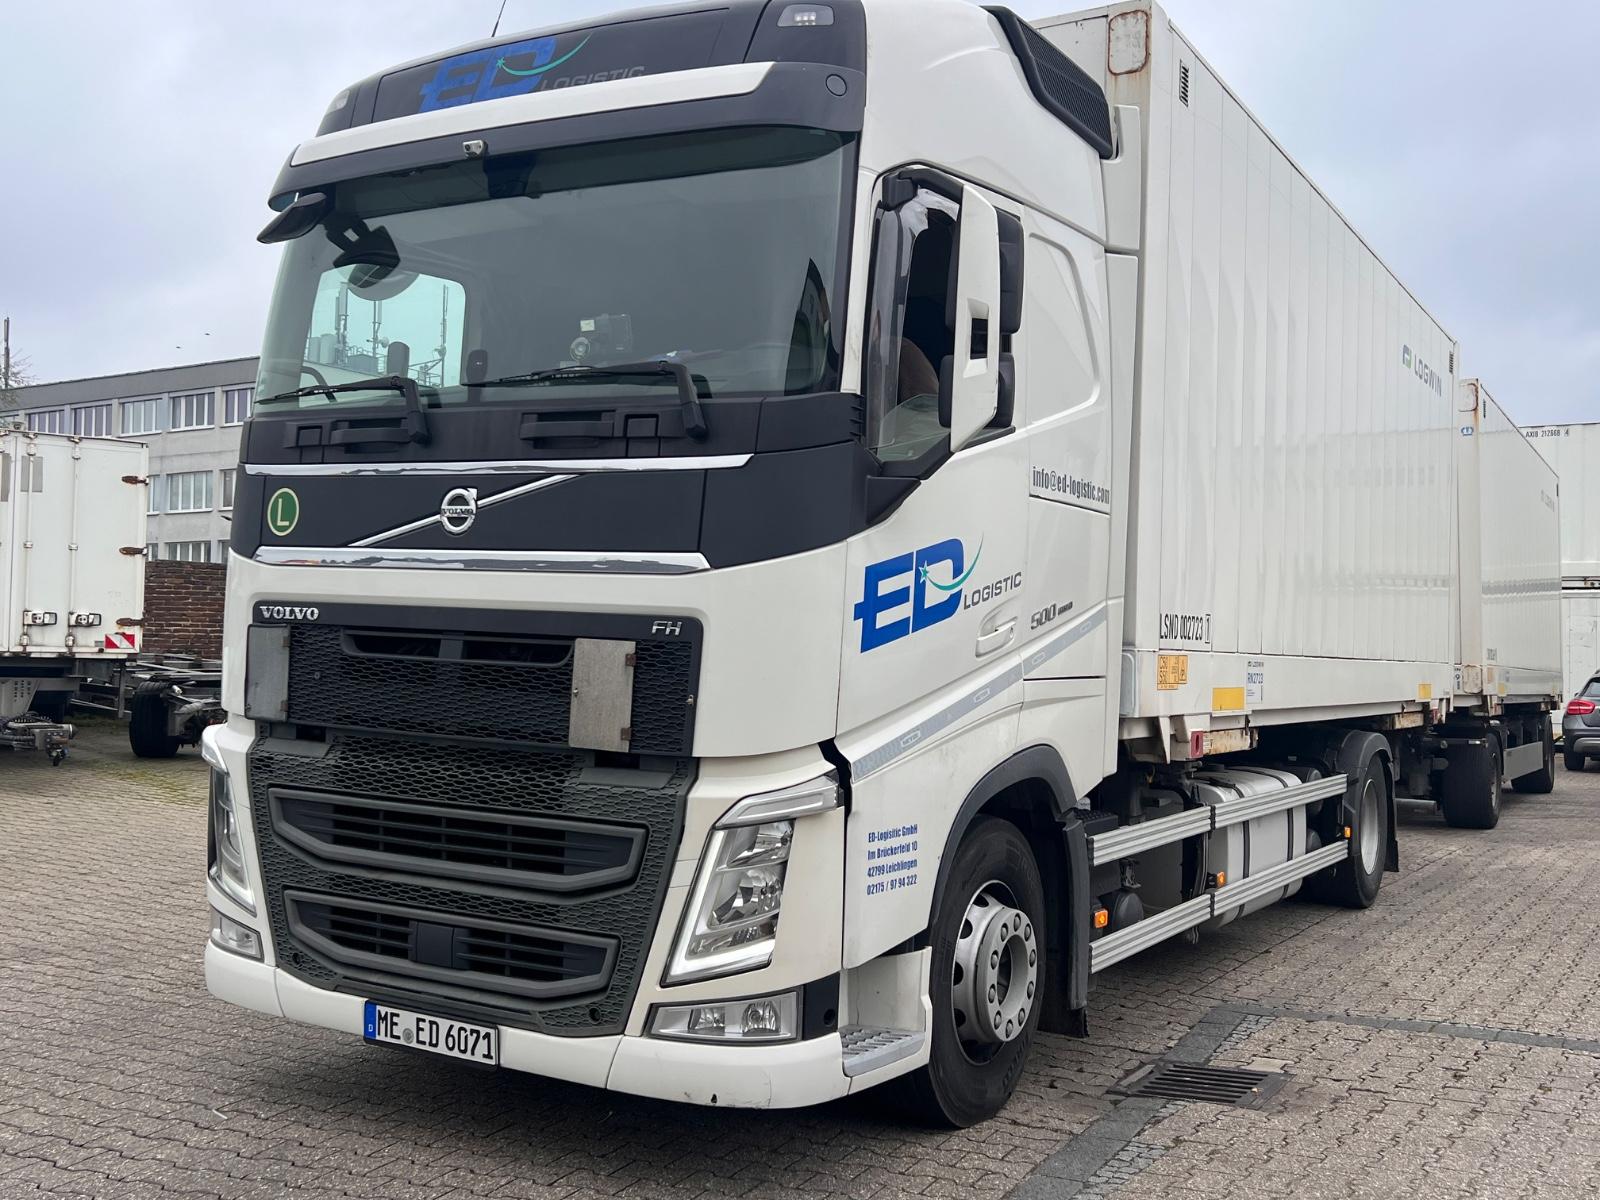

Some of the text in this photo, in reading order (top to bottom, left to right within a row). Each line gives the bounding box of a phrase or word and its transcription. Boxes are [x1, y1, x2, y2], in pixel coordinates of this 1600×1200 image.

[1415, 354, 1442, 397] LOGWIN
[1033, 466, 1110, 504] info@ed-logistic.com
[277, 499, 290, 526] L
[441, 508, 475, 516] VOLVO
[854, 538, 964, 654] ED
[963, 571, 1022, 610] LOGISTIC
[260, 606, 319, 620] VOLVO
[1031, 603, 1056, 630] 500
[652, 620, 682, 635] FH
[1160, 613, 1178, 640] LSND
[1180, 614, 1203, 641] 002723
[868, 824, 917, 842] ED-Logistic GmbH
[868, 850, 876, 860] Im
[911, 841, 917, 851] 10
[867, 859, 917, 877] 42799 Leichlingen
[867, 882, 884, 896] 02175
[890, 878, 897, 890] 97
[898, 877, 905, 888] 94
[907, 874, 917, 886] 322
[368, 1009, 494, 1060] D ME ED 6071
